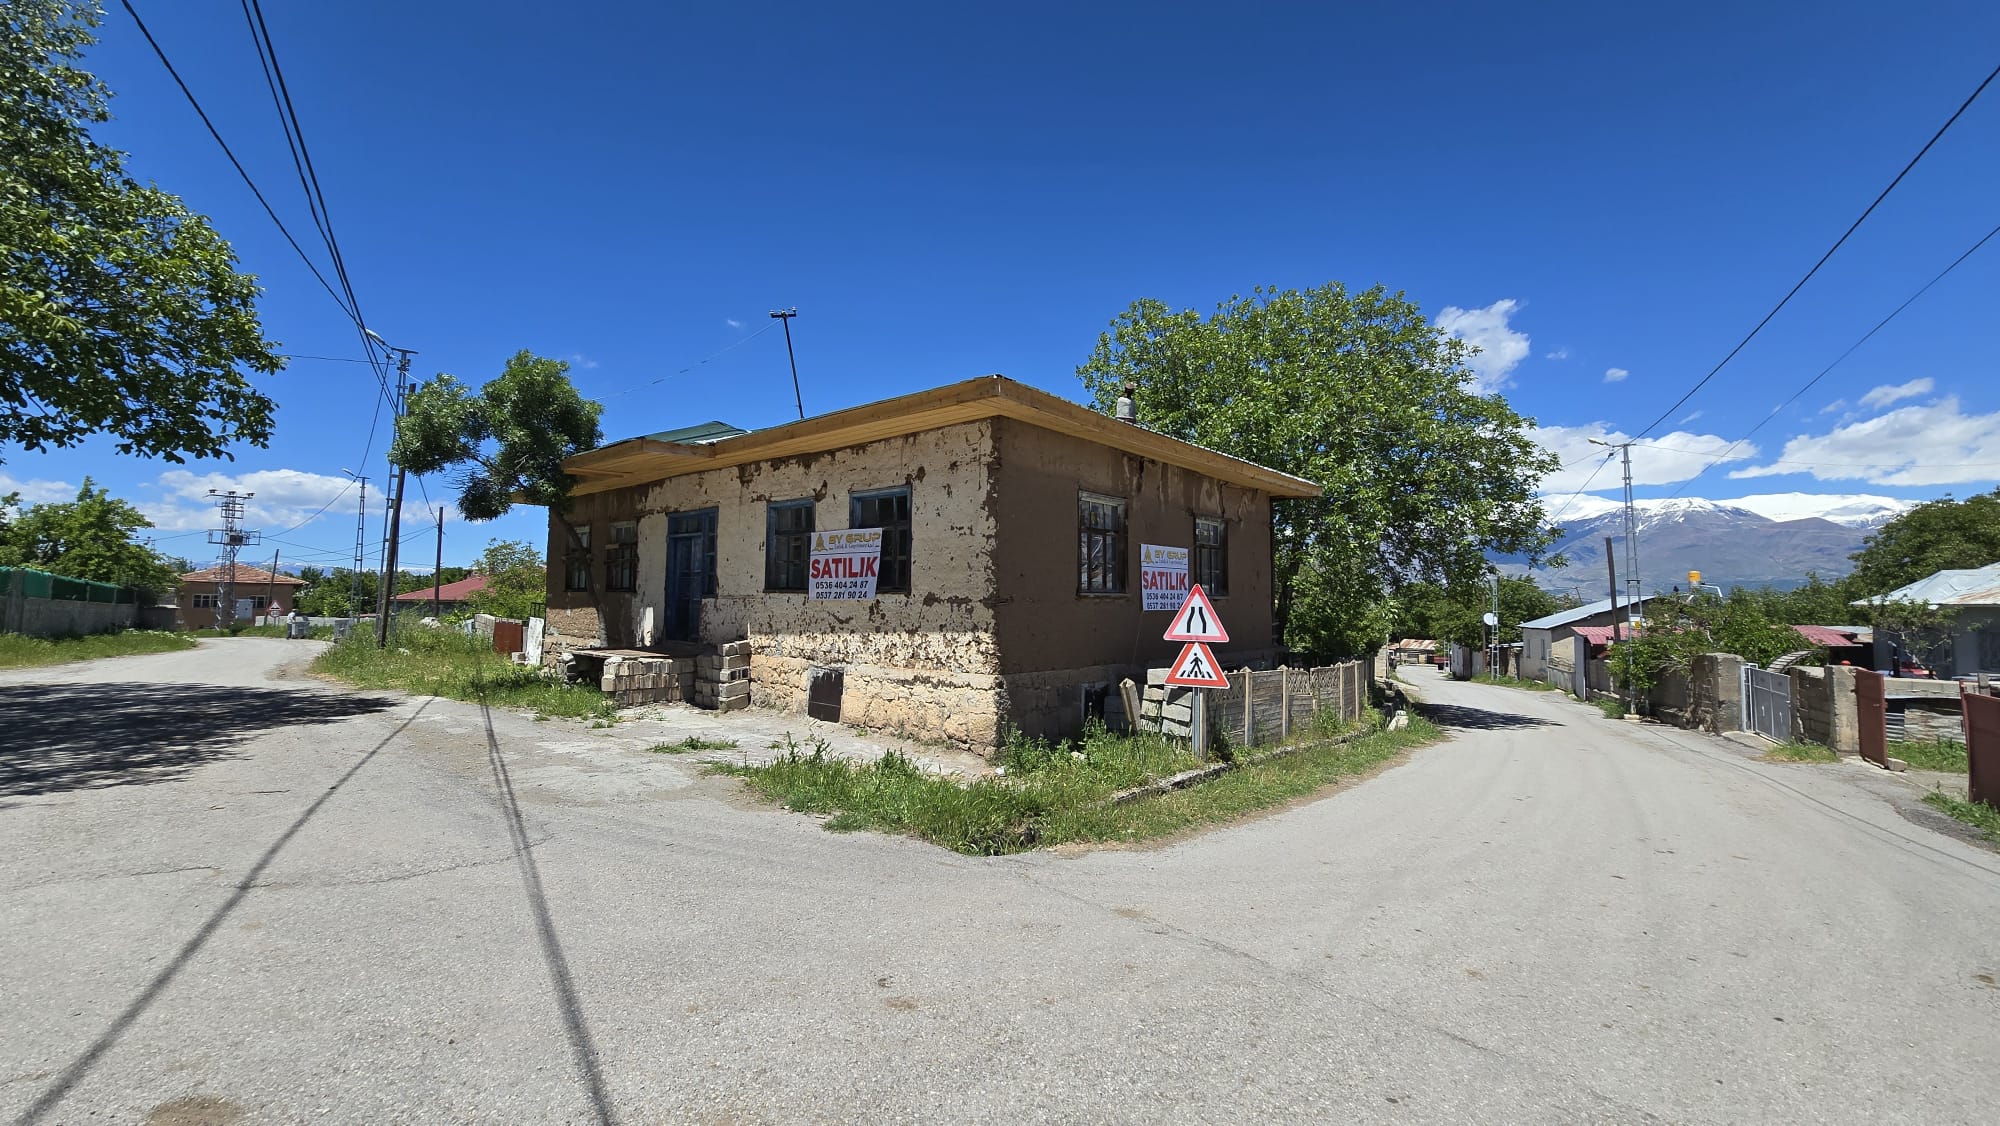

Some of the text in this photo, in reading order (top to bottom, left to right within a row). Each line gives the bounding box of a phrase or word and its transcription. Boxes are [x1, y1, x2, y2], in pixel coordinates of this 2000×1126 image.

[845, 533, 880, 543] GRUP
[811, 557, 878, 579] SATILIK
[1143, 571, 1187, 590] SATILIK
